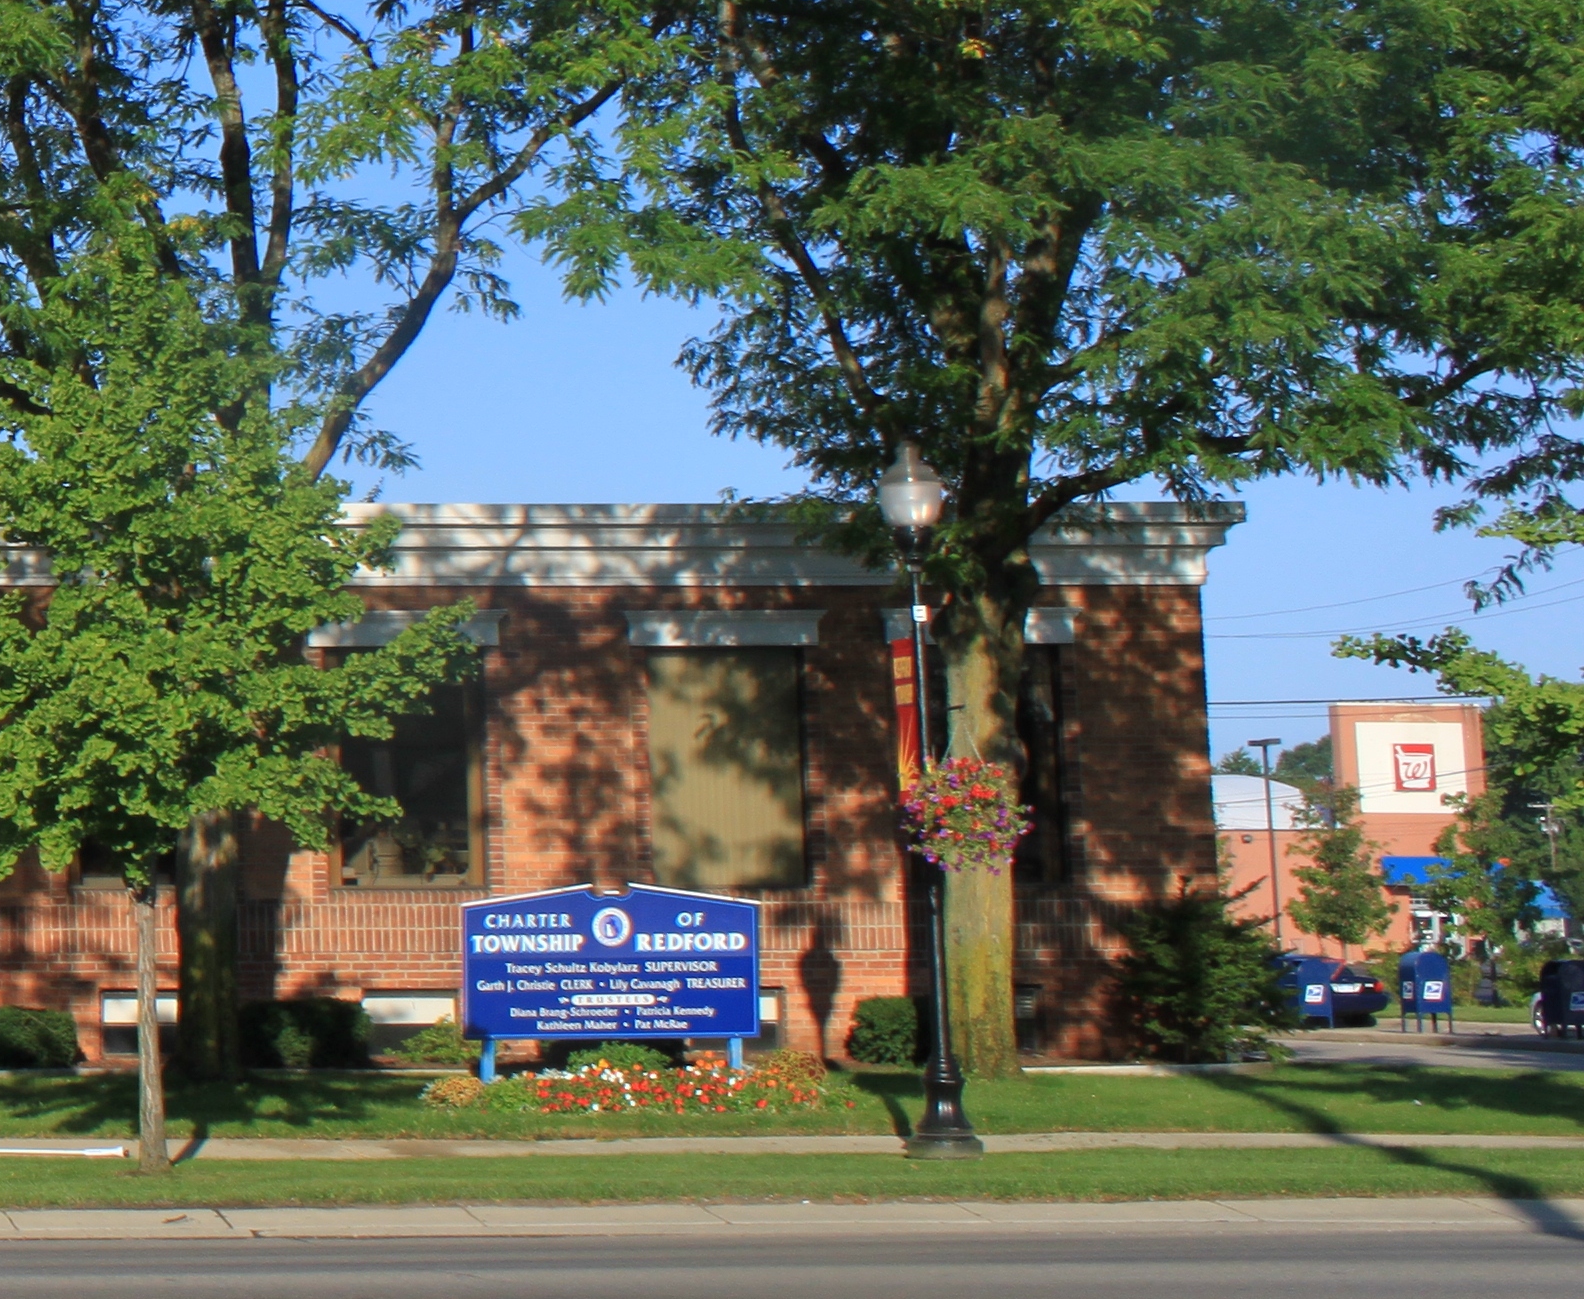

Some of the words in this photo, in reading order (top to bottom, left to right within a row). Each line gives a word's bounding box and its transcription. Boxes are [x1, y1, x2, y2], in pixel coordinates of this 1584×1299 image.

[483, 913, 572, 929] CHARTER
[675, 912, 705, 927] OF
[471, 934, 585, 953] TOWNSHIP
[634, 932, 747, 952] REDFORD
[505, 962, 542, 976] Tracey
[544, 961, 587, 973] Schultz
[589, 961, 638, 975] Kobylarz
[644, 961, 718, 973] SUPERVISOR
[476, 980, 505, 991] Garth
[516, 979, 556, 991] Christie
[560, 979, 593, 990] CLERK
[609, 978, 628, 992] Lily
[630, 978, 680, 992] Cavanagh
[685, 977, 746, 989] TREASURER
[576, 995, 651, 1004] TRUSTEES
[510, 1007, 537, 1017] Diana
[636, 1006, 671, 1016] Patricia
[673, 1005, 715, 1017] Kennedy
[537, 1020, 581, 1030] Kathleen
[584, 1019, 618, 1030] Maher
[634, 1019, 651, 1029] Pat
[653, 1019, 688, 1029] McRae
